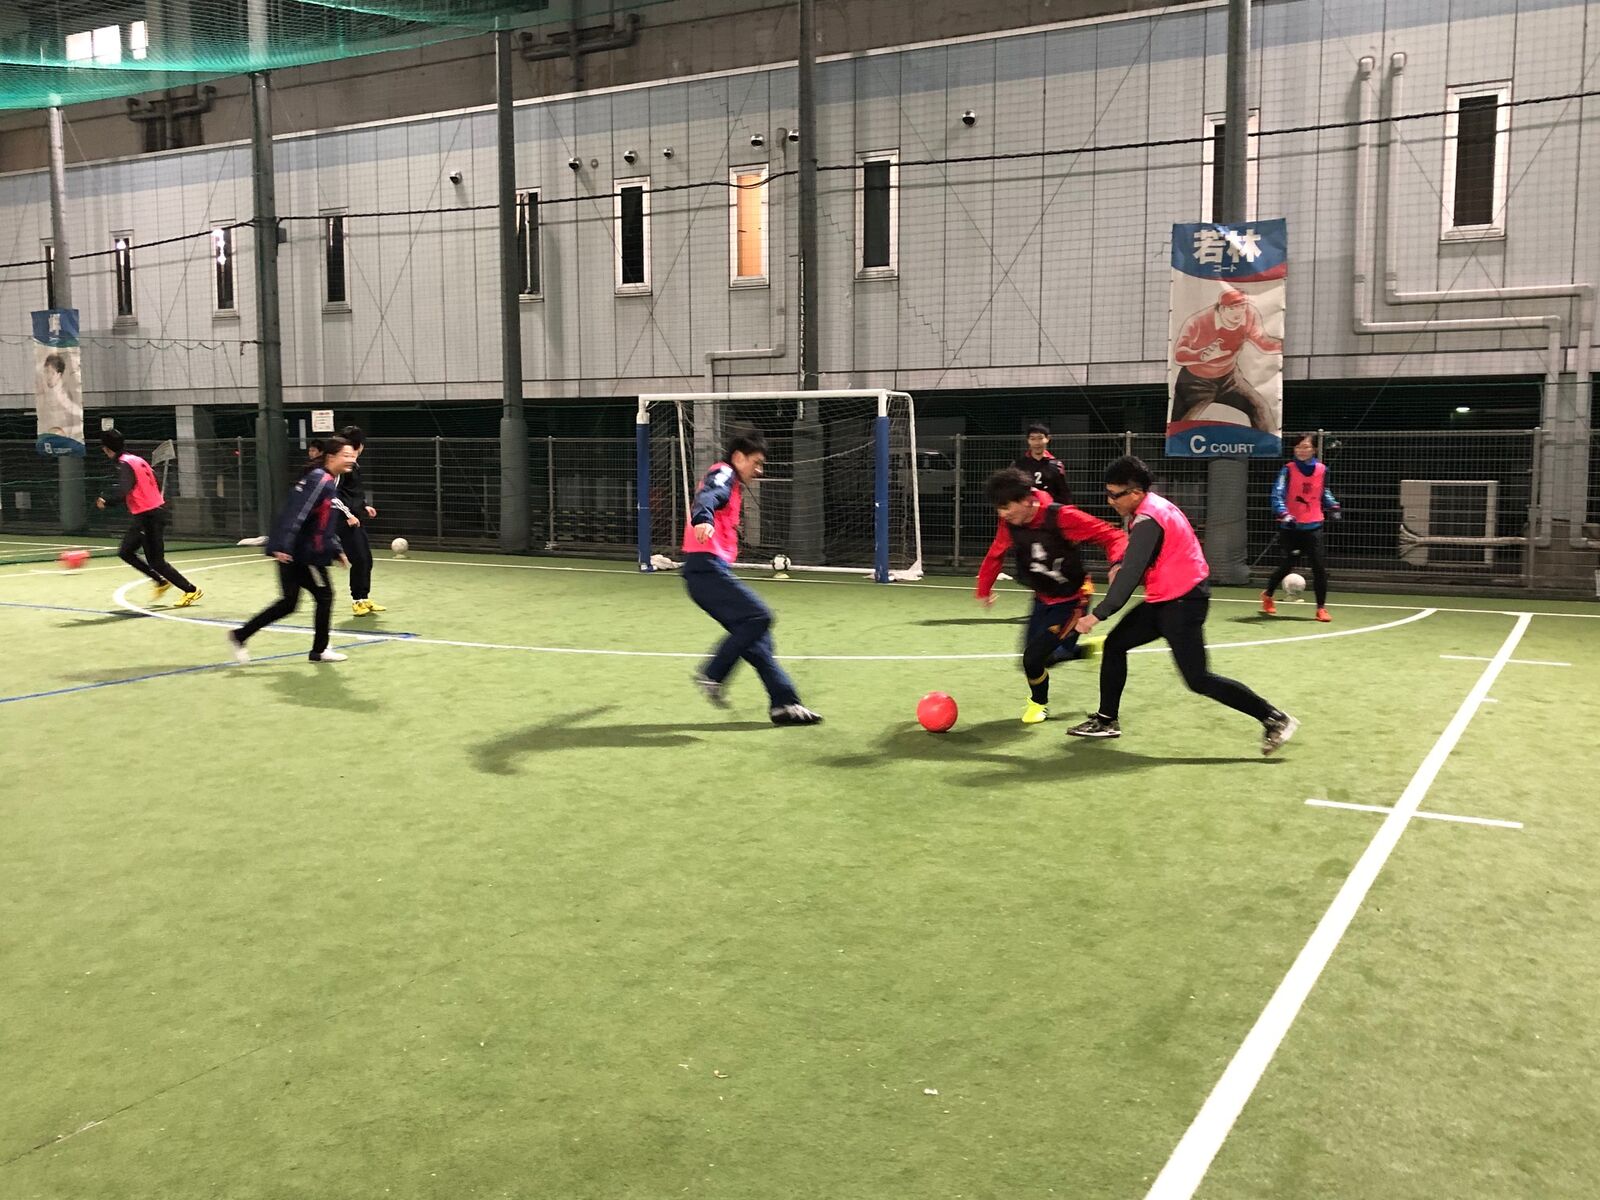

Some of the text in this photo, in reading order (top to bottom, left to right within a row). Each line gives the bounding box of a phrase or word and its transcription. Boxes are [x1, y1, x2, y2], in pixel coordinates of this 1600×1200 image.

[1193, 229, 1262, 264] 若林
[1213, 264, 1237, 272] コート
[1190, 435, 1255, 454] C COURT
[1034, 472, 1042, 484] 2
